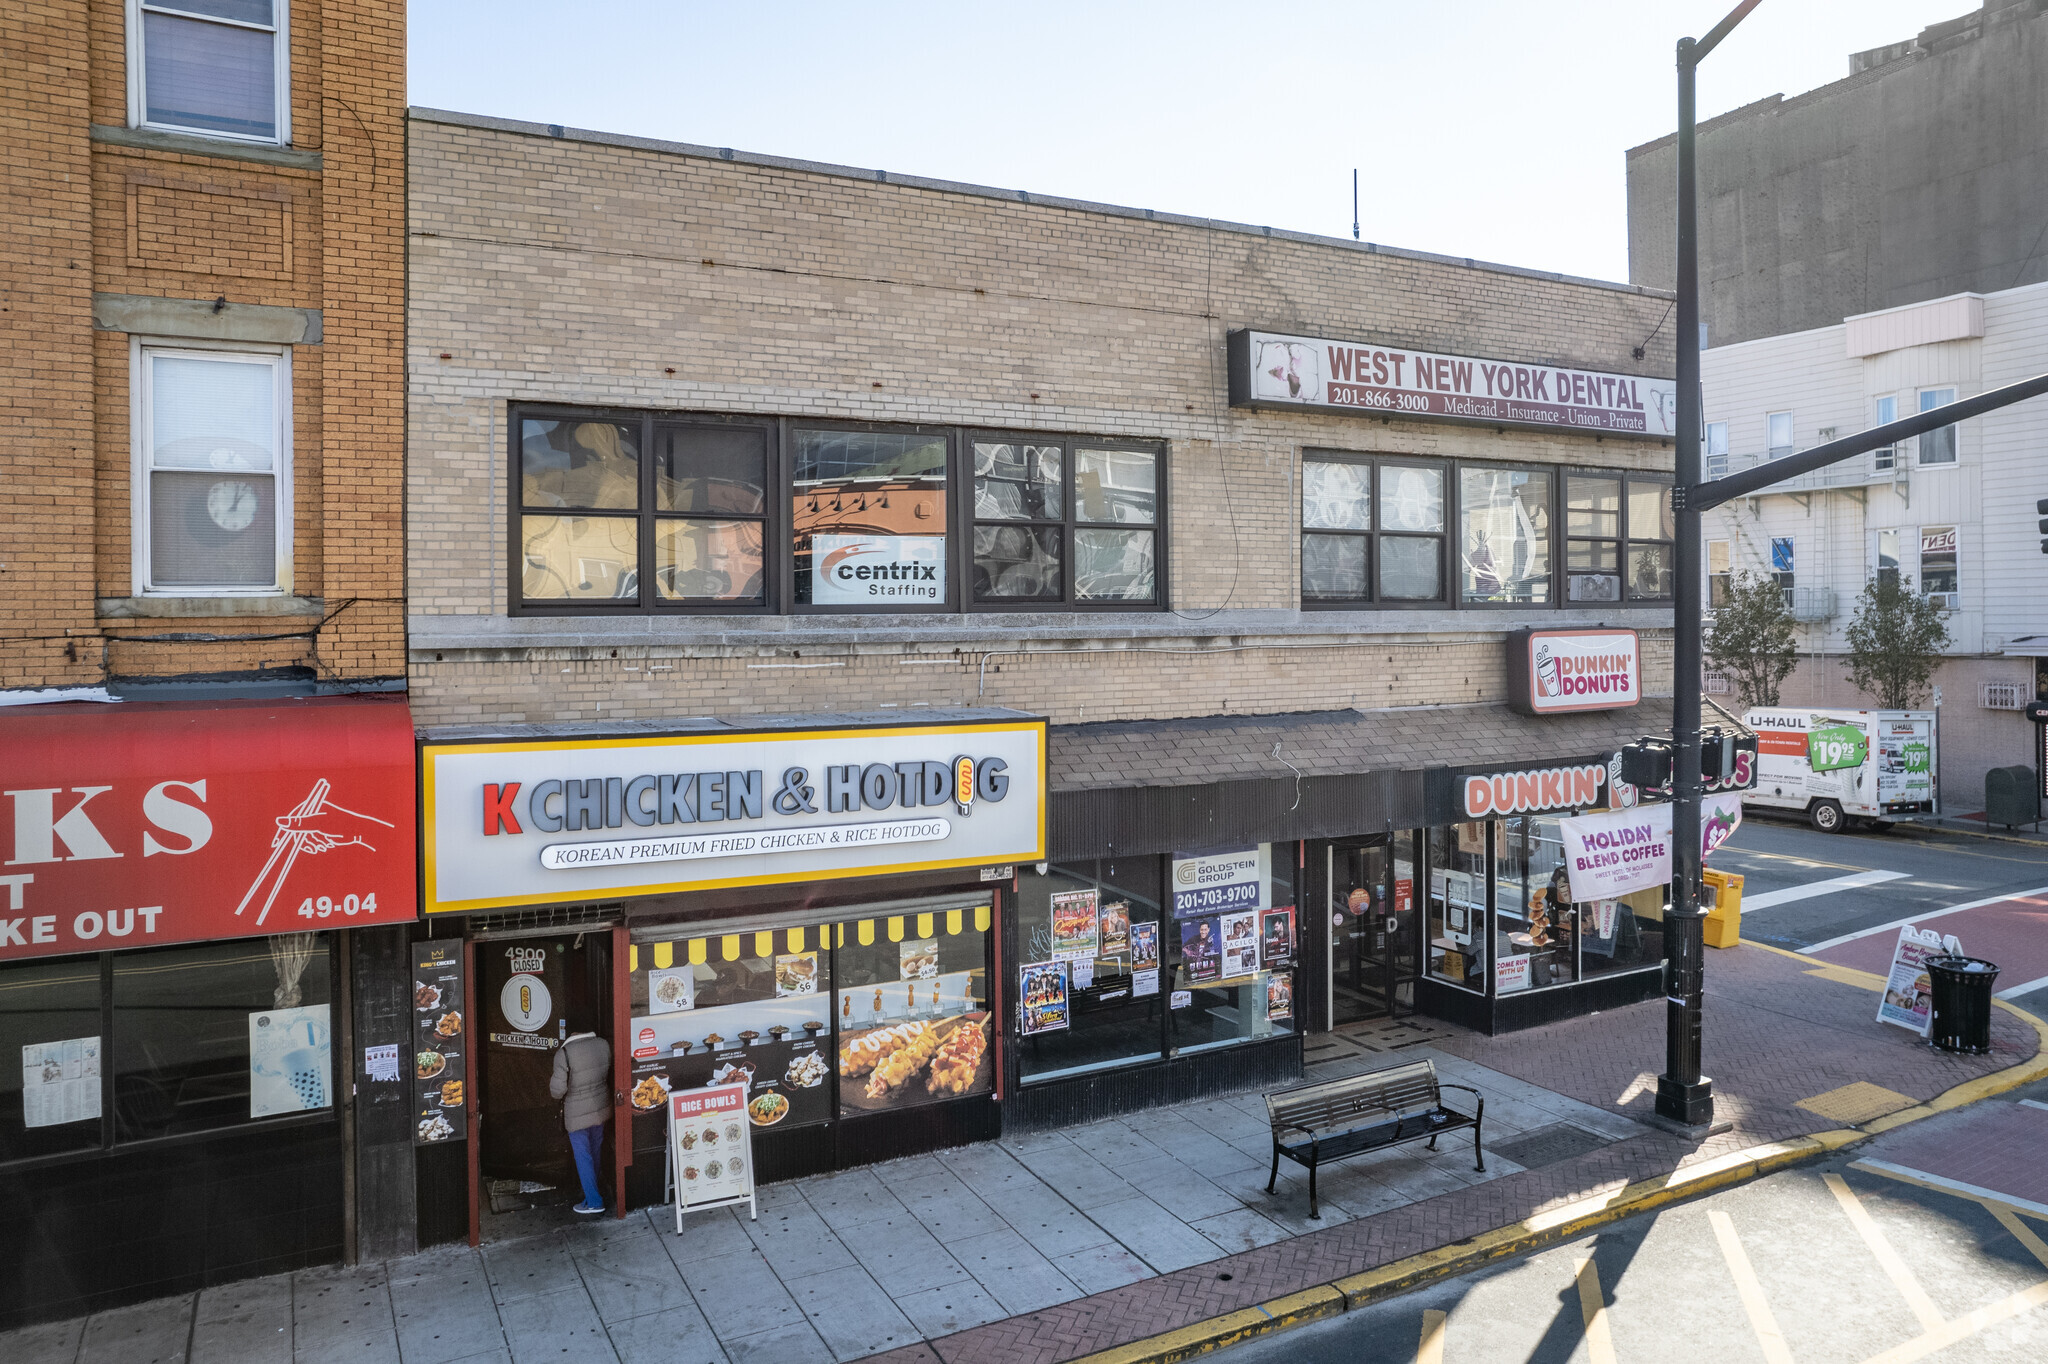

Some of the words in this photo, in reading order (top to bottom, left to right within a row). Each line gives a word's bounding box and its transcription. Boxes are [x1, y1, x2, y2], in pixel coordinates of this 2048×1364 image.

[1327, 346, 1406, 387] WEST
[1415, 356, 1473, 394] NEW
[1481, 363, 1549, 402] YORK
[1556, 372, 1644, 410] DENTAL
[1333, 387, 1429, 411] 201-866-3000
[1443, 396, 1498, 417] Medicaid
[1506, 402, 1559, 423] Insurance
[1568, 408, 1601, 426] Union
[1609, 412, 1644, 430] Private
[837, 561, 936, 580] centrix
[868, 584, 937, 598] Staffing
[1561, 654, 1632, 675] DUNKIN'
[1562, 673, 1630, 696] DONUTS
[1750, 716, 1806, 729] U-HAUL
[1891, 723, 1914, 731] U-HAUL
[1464, 764, 1606, 817] DUNKIN'
[483, 782, 523, 836] K
[529, 769, 763, 833] CHICKEN
[772, 766, 819, 816] &
[555, 844, 627, 864] KOREAN
[629, 840, 709, 860] PREMIUM
[710, 837, 756, 853] FRIED
[760, 832, 827, 850] CHICKEN
[830, 829, 841, 843] &
[844, 828, 878, 843] RICE
[881, 823, 941, 840] HOTDOG
[1581, 824, 1652, 852] HOLIDAY
[1576, 850, 1619, 871] BLEND
[1622, 843, 1665, 863] COFFEE
[1198, 860, 1255, 875] GOLDSTEIN
[1198, 871, 1235, 884] GROUP
[297, 892, 378, 920] 49-04
[1177, 884, 1256, 910] 201-703-9700
[73, 906, 163, 940] OUT
[1223, 937, 1258, 950] BACILOS
[505, 947, 546, 960] 4900
[1515, 958, 1528, 966] RUN
[514, 960, 540, 972] CLOSED
[1499, 968, 1516, 976] WITH
[799, 982, 811, 993] $6
[676, 998, 688, 1008] $8
[496, 1033, 525, 1044] CHICKEN
[681, 1099, 702, 1113] RICE
[704, 1094, 736, 1109] BOWLS
